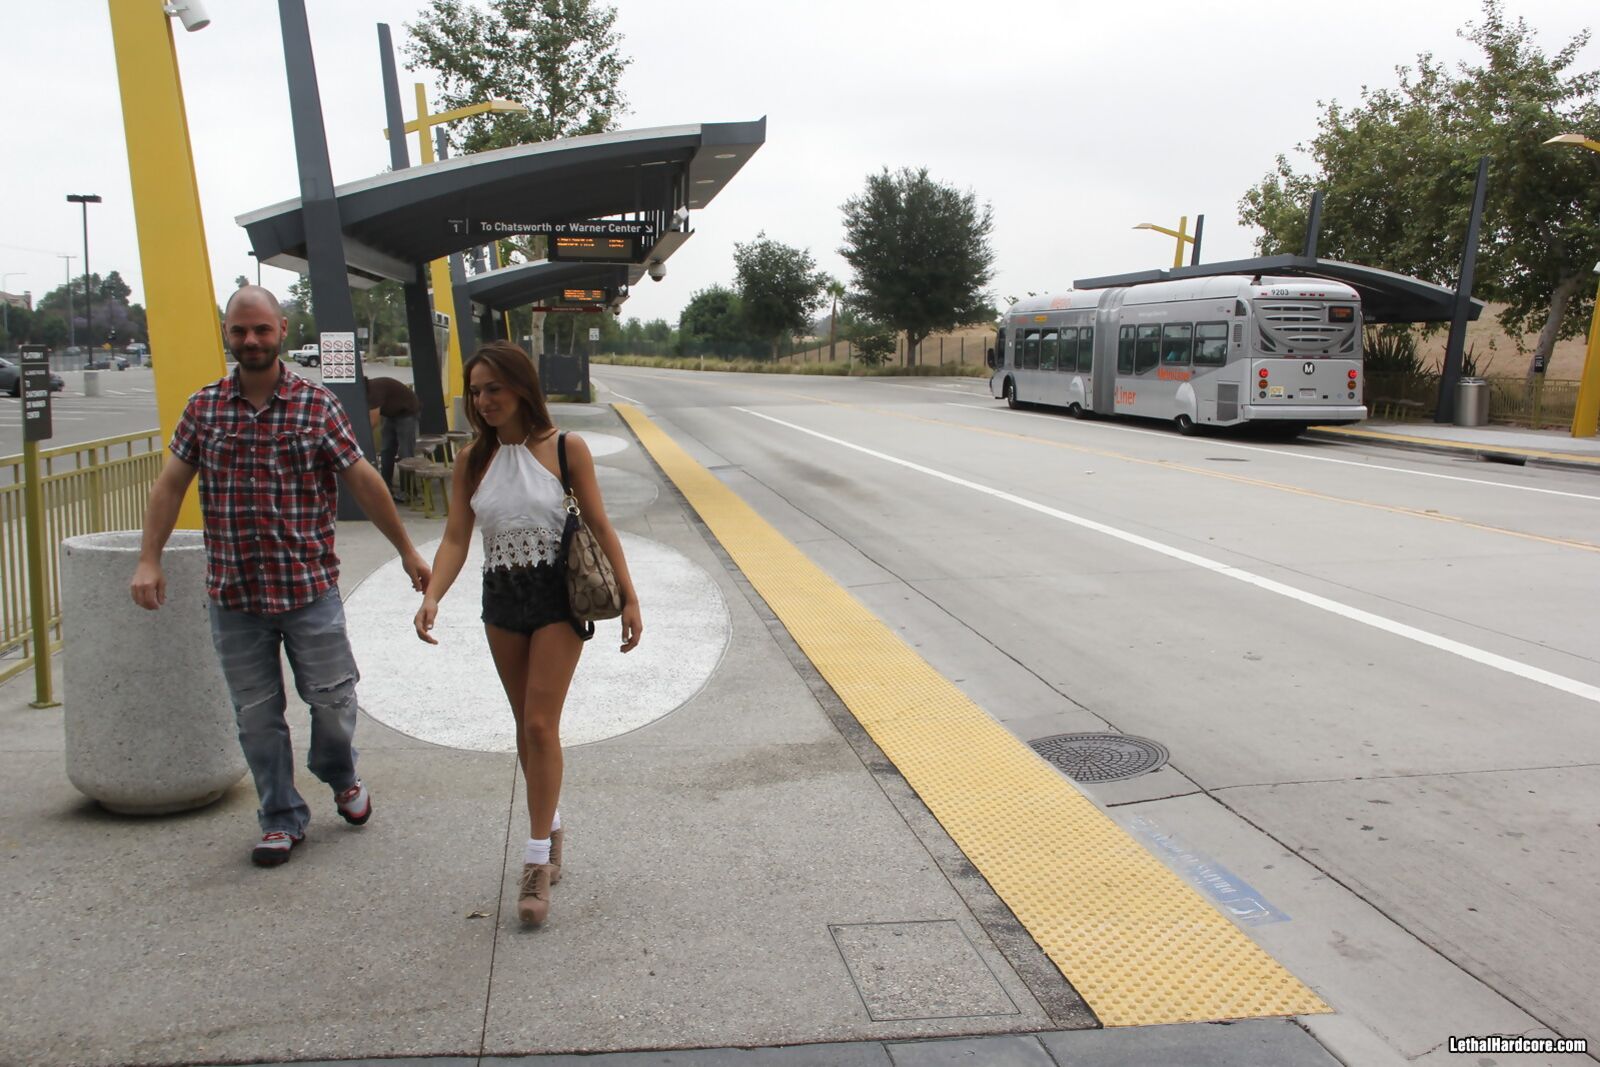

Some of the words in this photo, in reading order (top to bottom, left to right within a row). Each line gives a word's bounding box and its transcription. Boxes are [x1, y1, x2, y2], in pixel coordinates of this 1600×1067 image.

[480, 221, 492, 231] To
[494, 222, 552, 232] Chatsworth
[555, 224, 566, 232] or
[569, 222, 606, 232] Warner
[608, 223, 642, 233] Center
[1271, 288, 1289, 296] 9203
